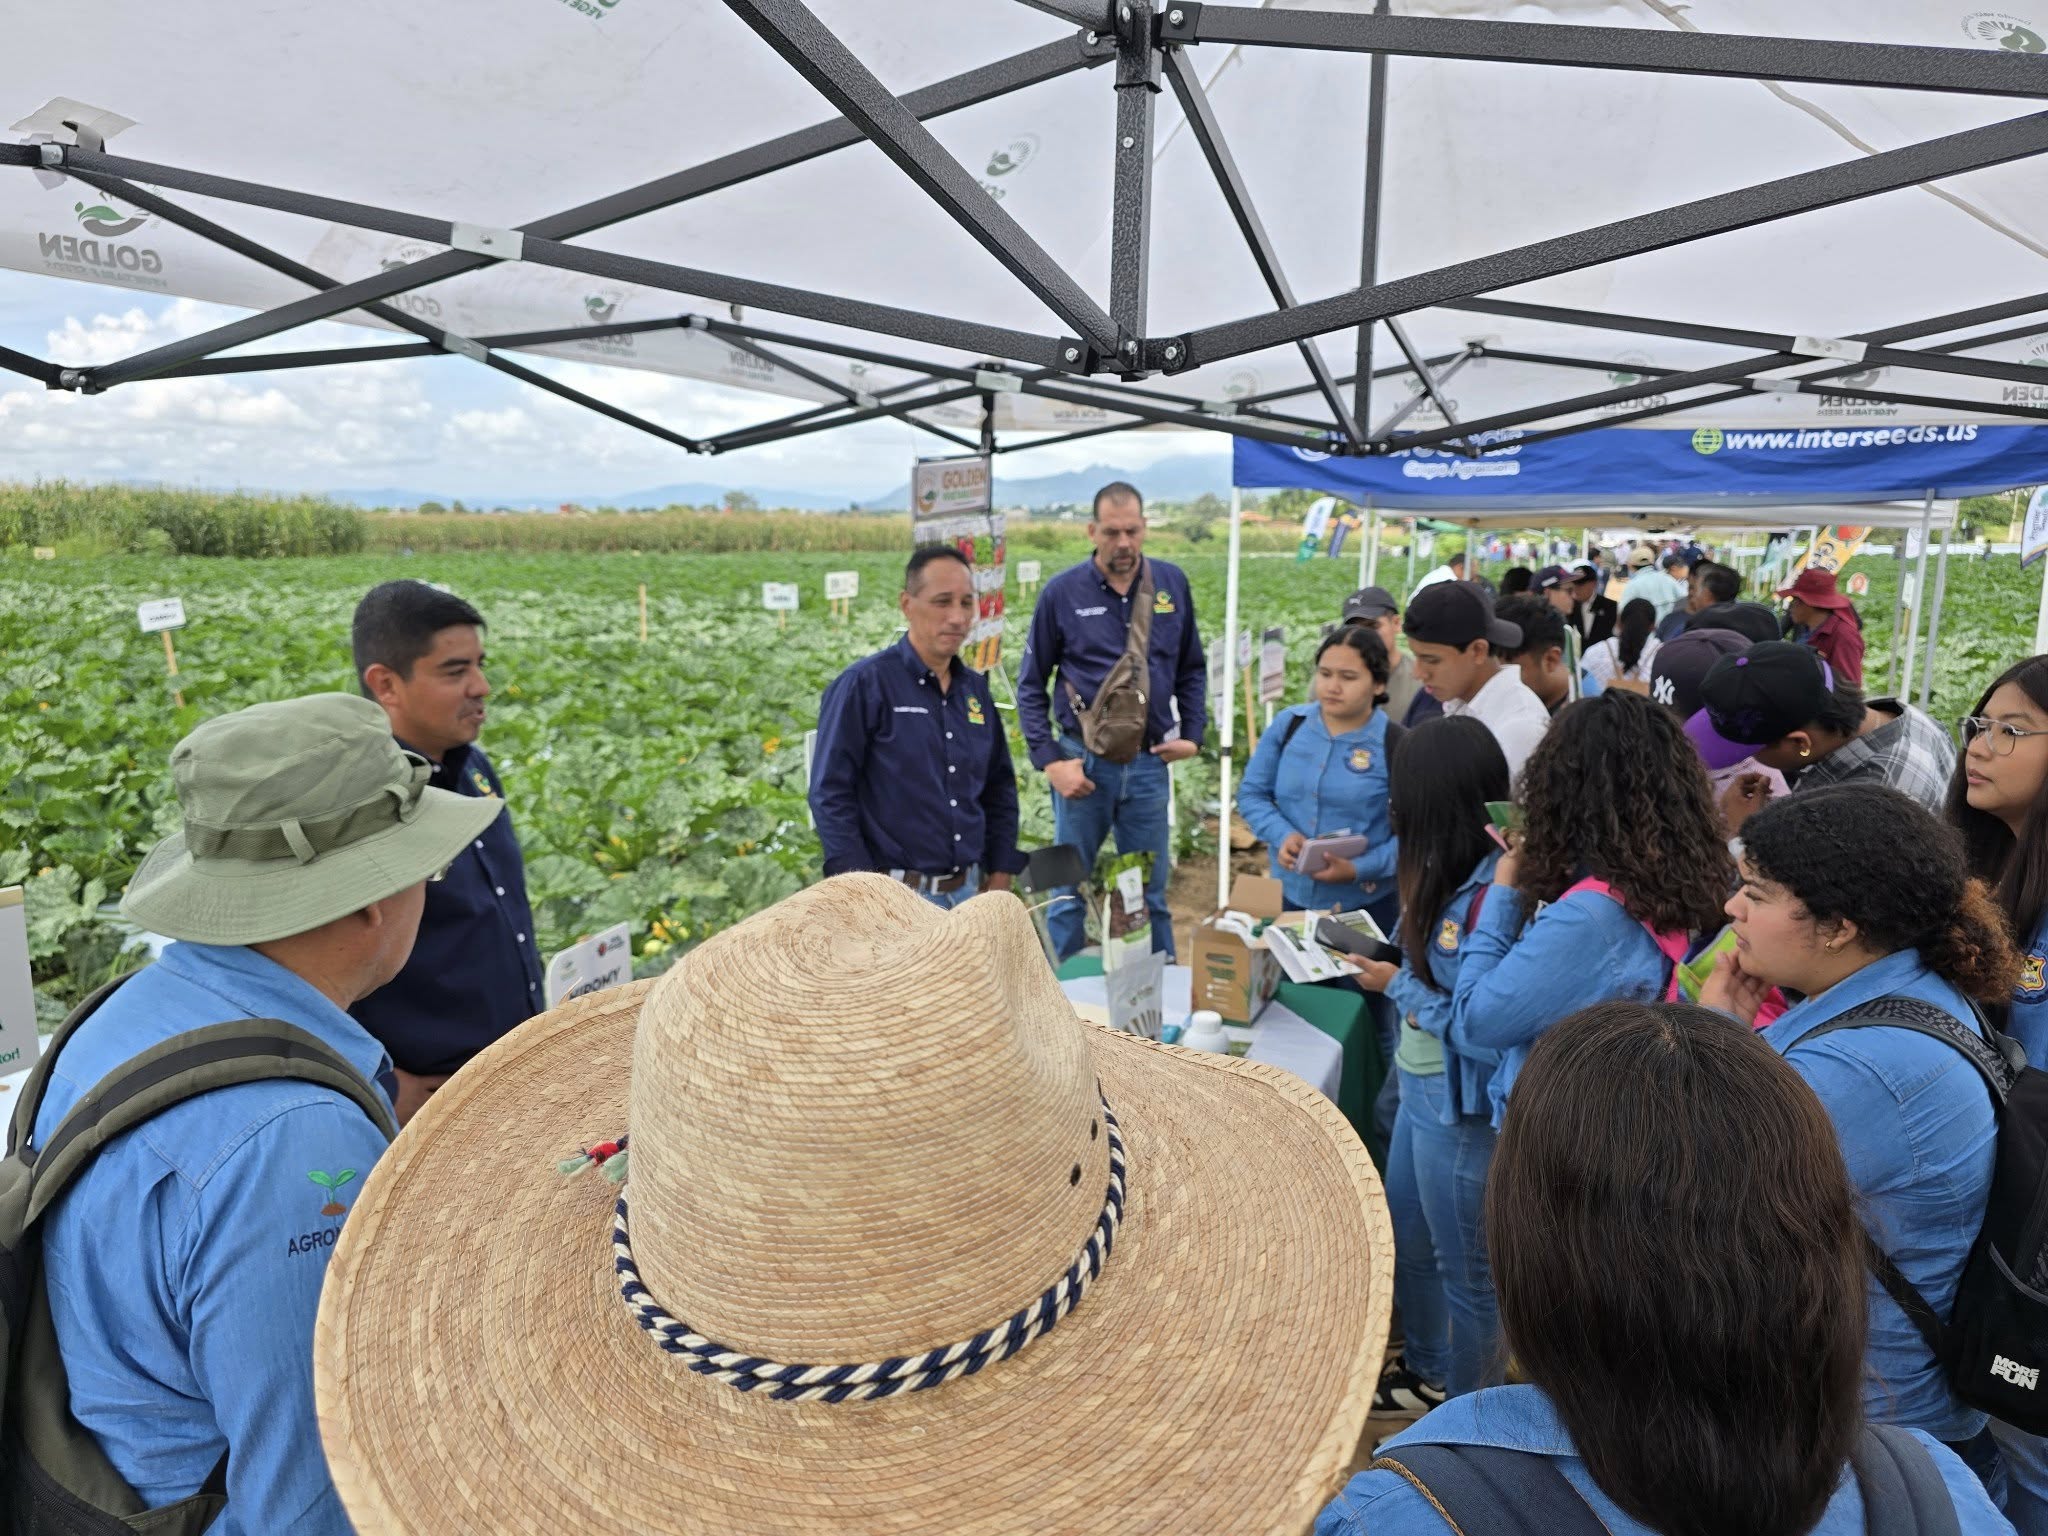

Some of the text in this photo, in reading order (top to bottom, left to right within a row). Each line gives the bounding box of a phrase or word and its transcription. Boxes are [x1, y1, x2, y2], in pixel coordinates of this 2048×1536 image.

[1726, 423, 1978, 450] www.interseeds.us
[1990, 1364, 2037, 1390] FUN
[1994, 1354, 2040, 1378] MORE
